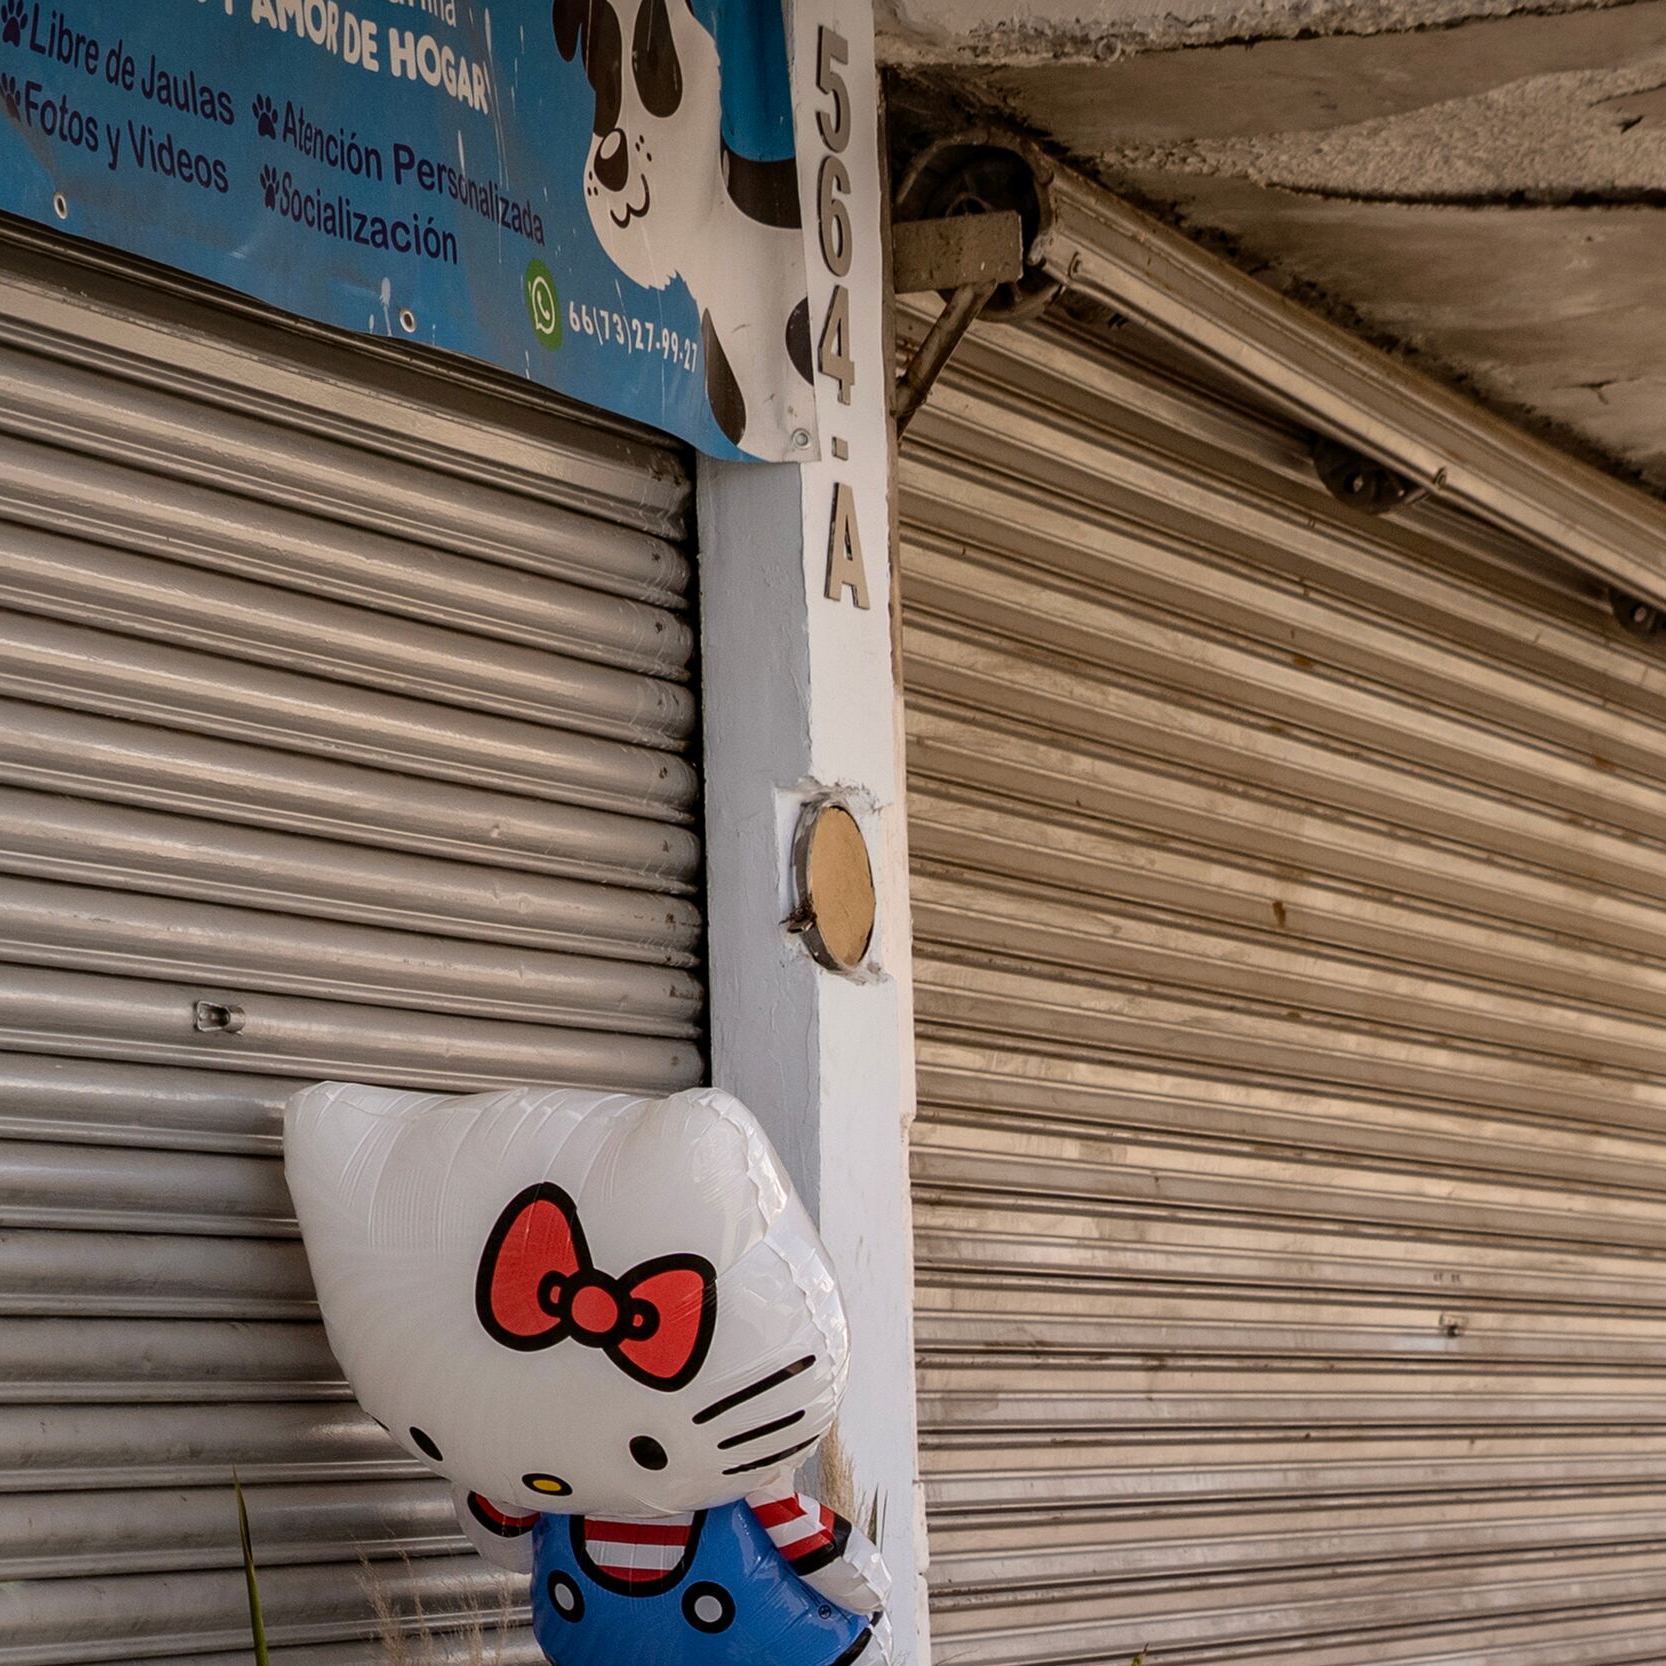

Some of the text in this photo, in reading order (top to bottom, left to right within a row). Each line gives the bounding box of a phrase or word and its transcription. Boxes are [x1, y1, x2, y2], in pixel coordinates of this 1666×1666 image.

[29, 3, 234, 126] Libre de Jaulas
[251, 0, 339, 54] AMOR
[343, 11, 380, 73] DE
[388, 27, 489, 115] HOGAR
[24, 79, 230, 194] Fotos y Videos
[283, 100, 545, 247] Atención Personalizada
[280, 171, 458, 265] Socialización
